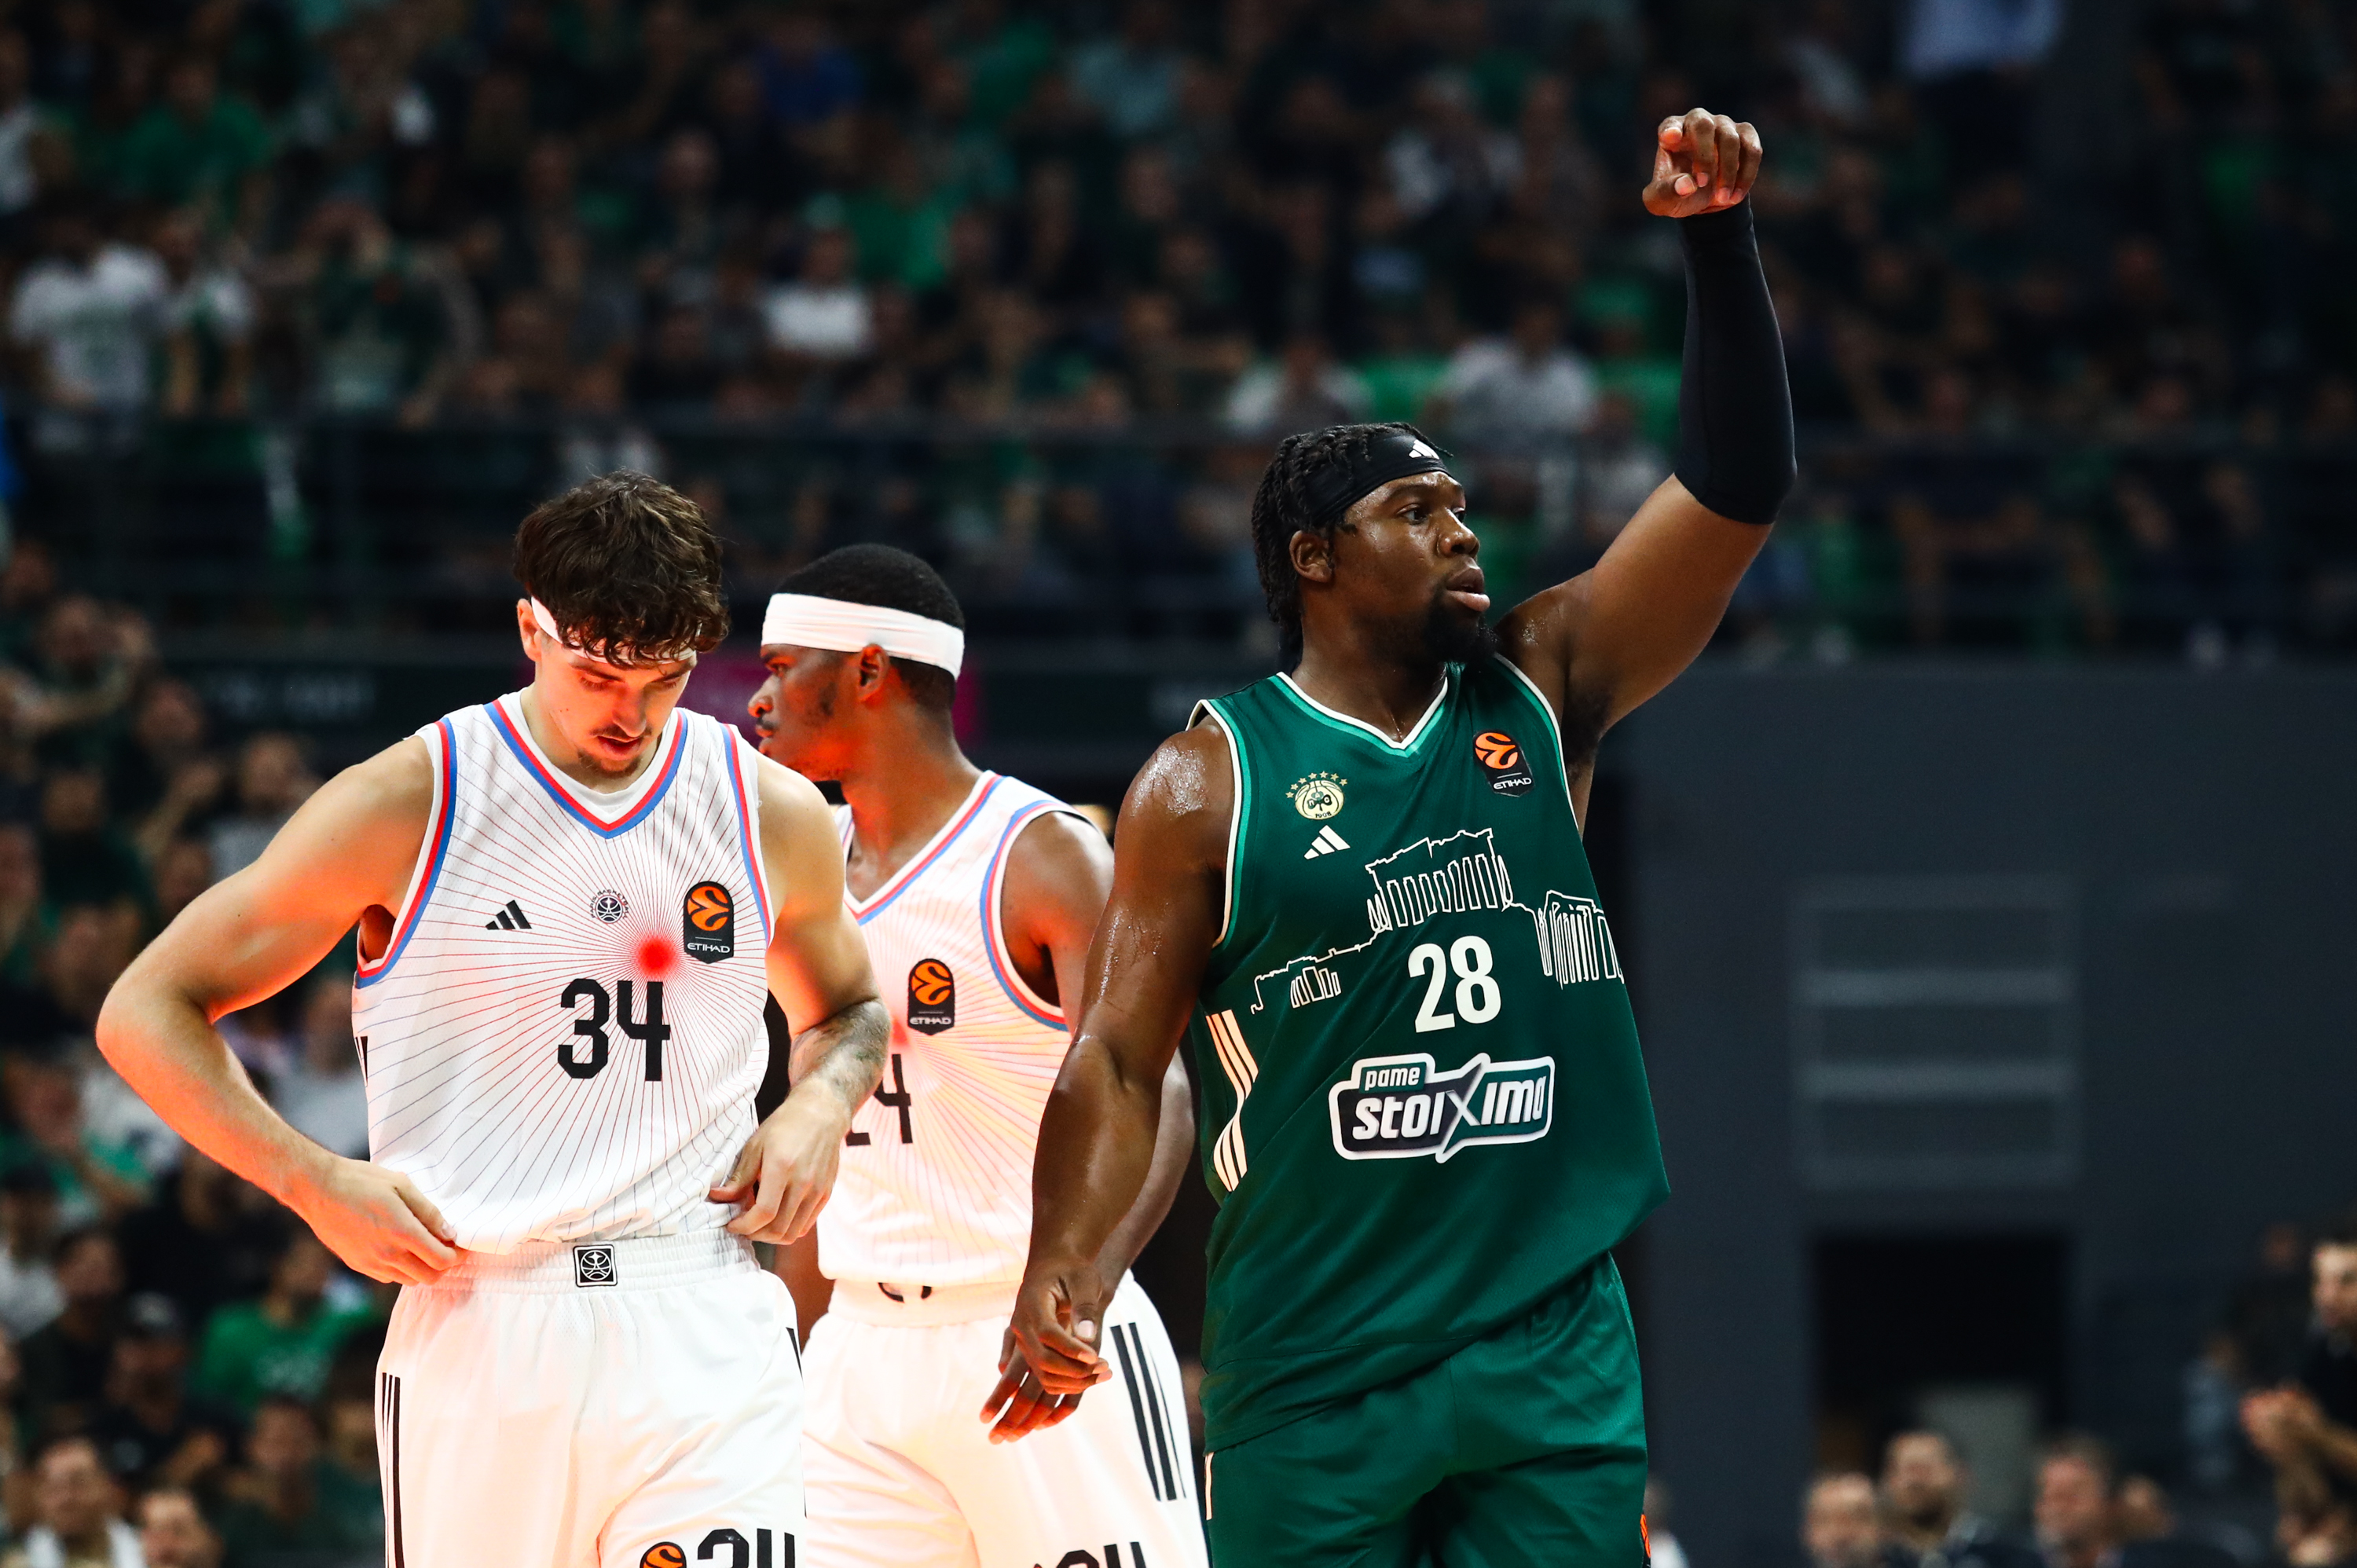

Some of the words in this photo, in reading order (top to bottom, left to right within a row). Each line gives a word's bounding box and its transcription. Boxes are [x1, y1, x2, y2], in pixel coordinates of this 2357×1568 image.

[1493, 777, 1532, 790] ETIHAD
[687, 943, 730, 954] ETIHAD
[1408, 935, 1501, 1033] 28
[557, 978, 670, 1081] 34
[910, 1016, 951, 1025] ETIHAD
[1364, 1067, 1420, 1091] pame
[845, 1053, 913, 1146] 4
